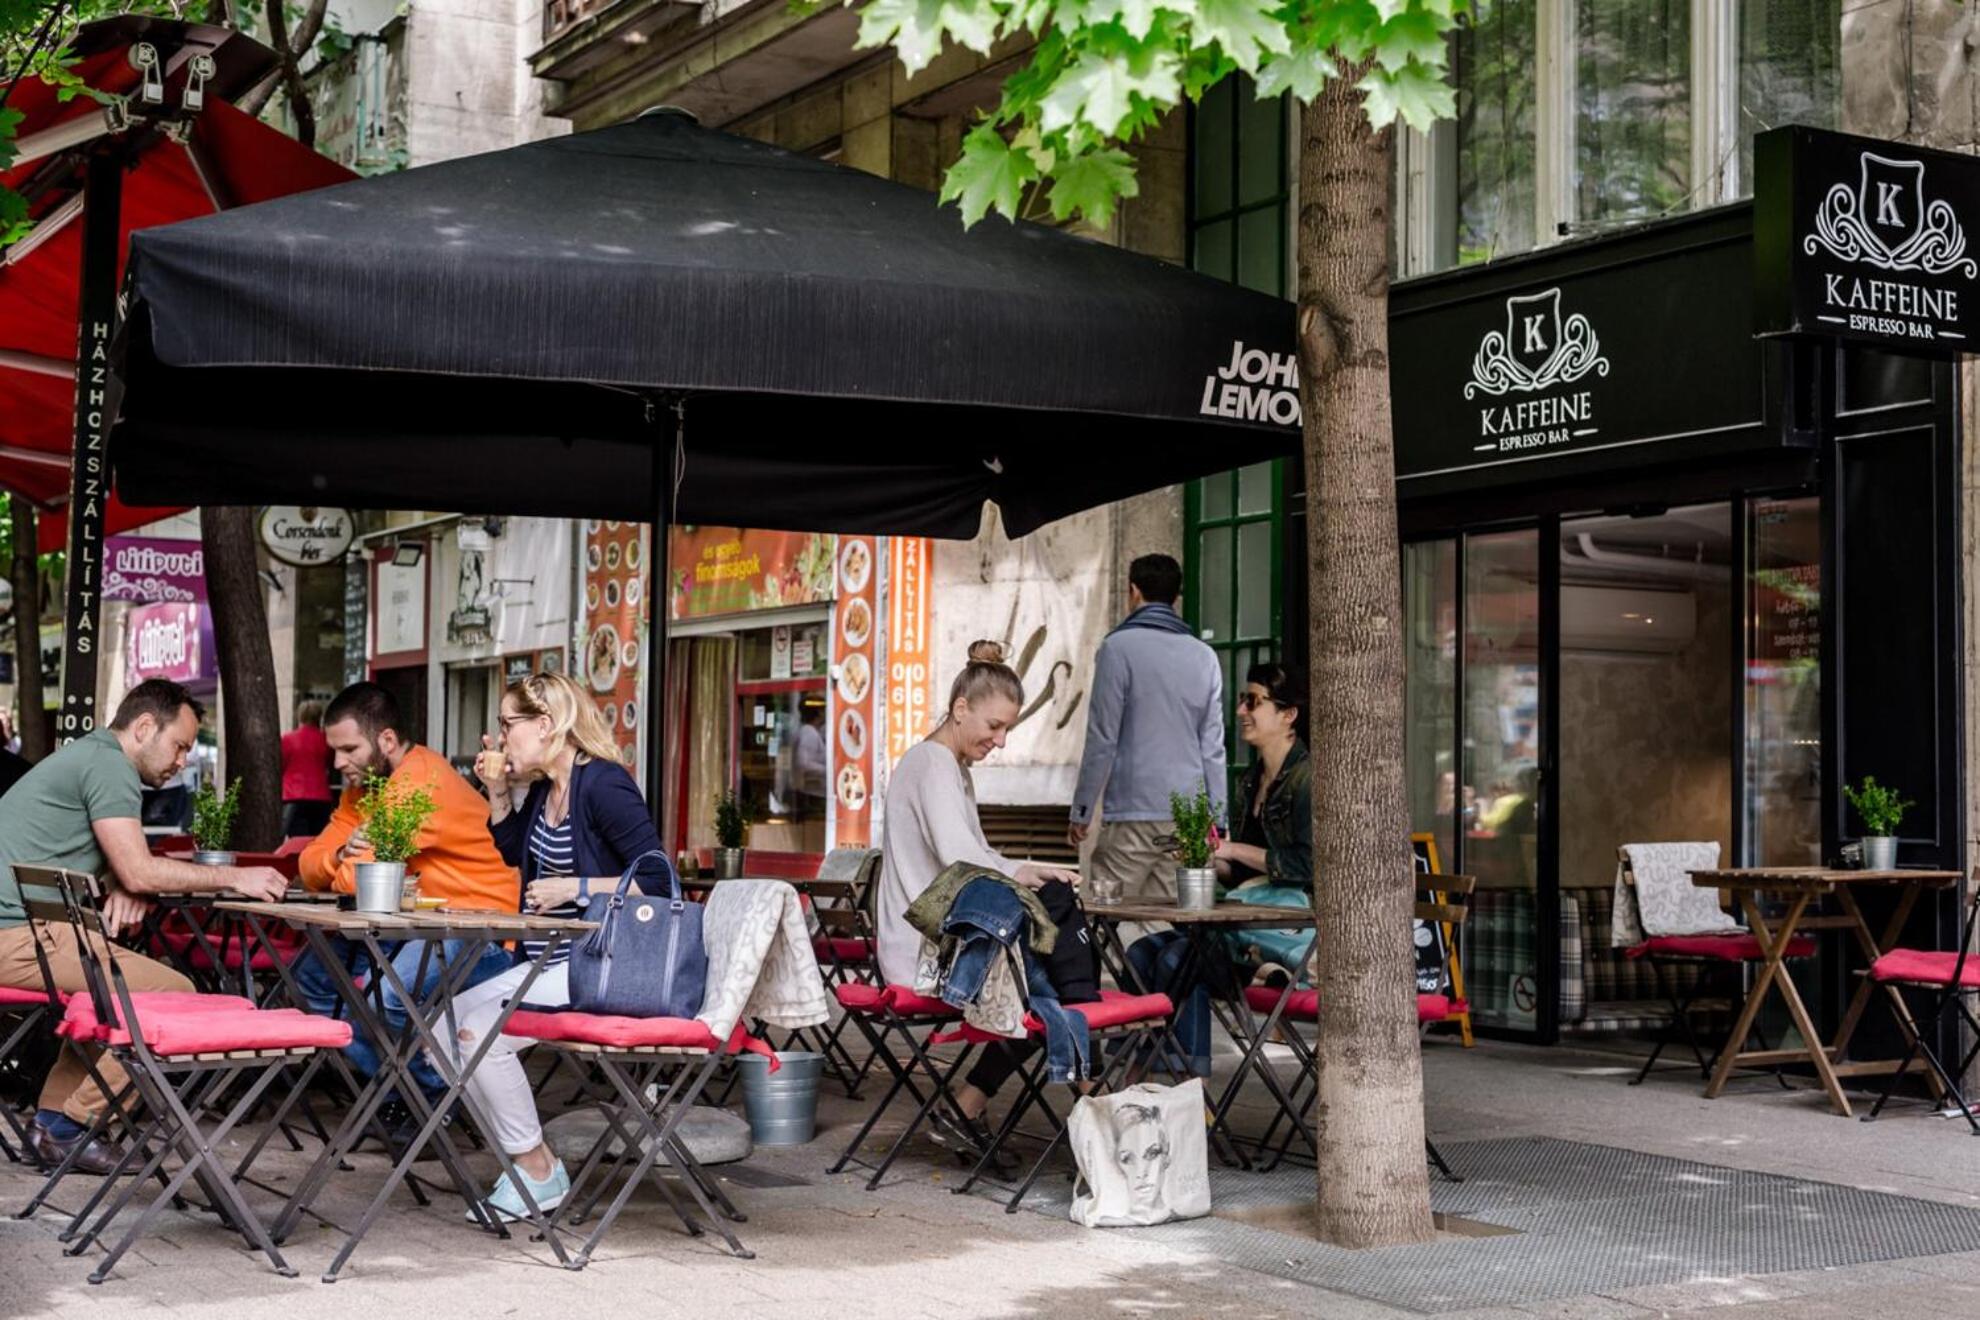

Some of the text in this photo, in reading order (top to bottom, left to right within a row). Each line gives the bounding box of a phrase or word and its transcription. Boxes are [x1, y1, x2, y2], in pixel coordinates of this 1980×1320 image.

[1876, 181, 1906, 228] K
[1824, 273, 1959, 321] KAFFEINE
[1523, 314, 1549, 354] K
[1850, 314, 1935, 340] ESPRESSO BAR
[1199, 375, 1303, 427] LEMO
[1480, 392, 1592, 436] KAFFEINE
[1500, 428, 1570, 451] ESPRESSO BAR
[77, 321, 108, 653] HÁZHOZSZÁLLÍTÁS
